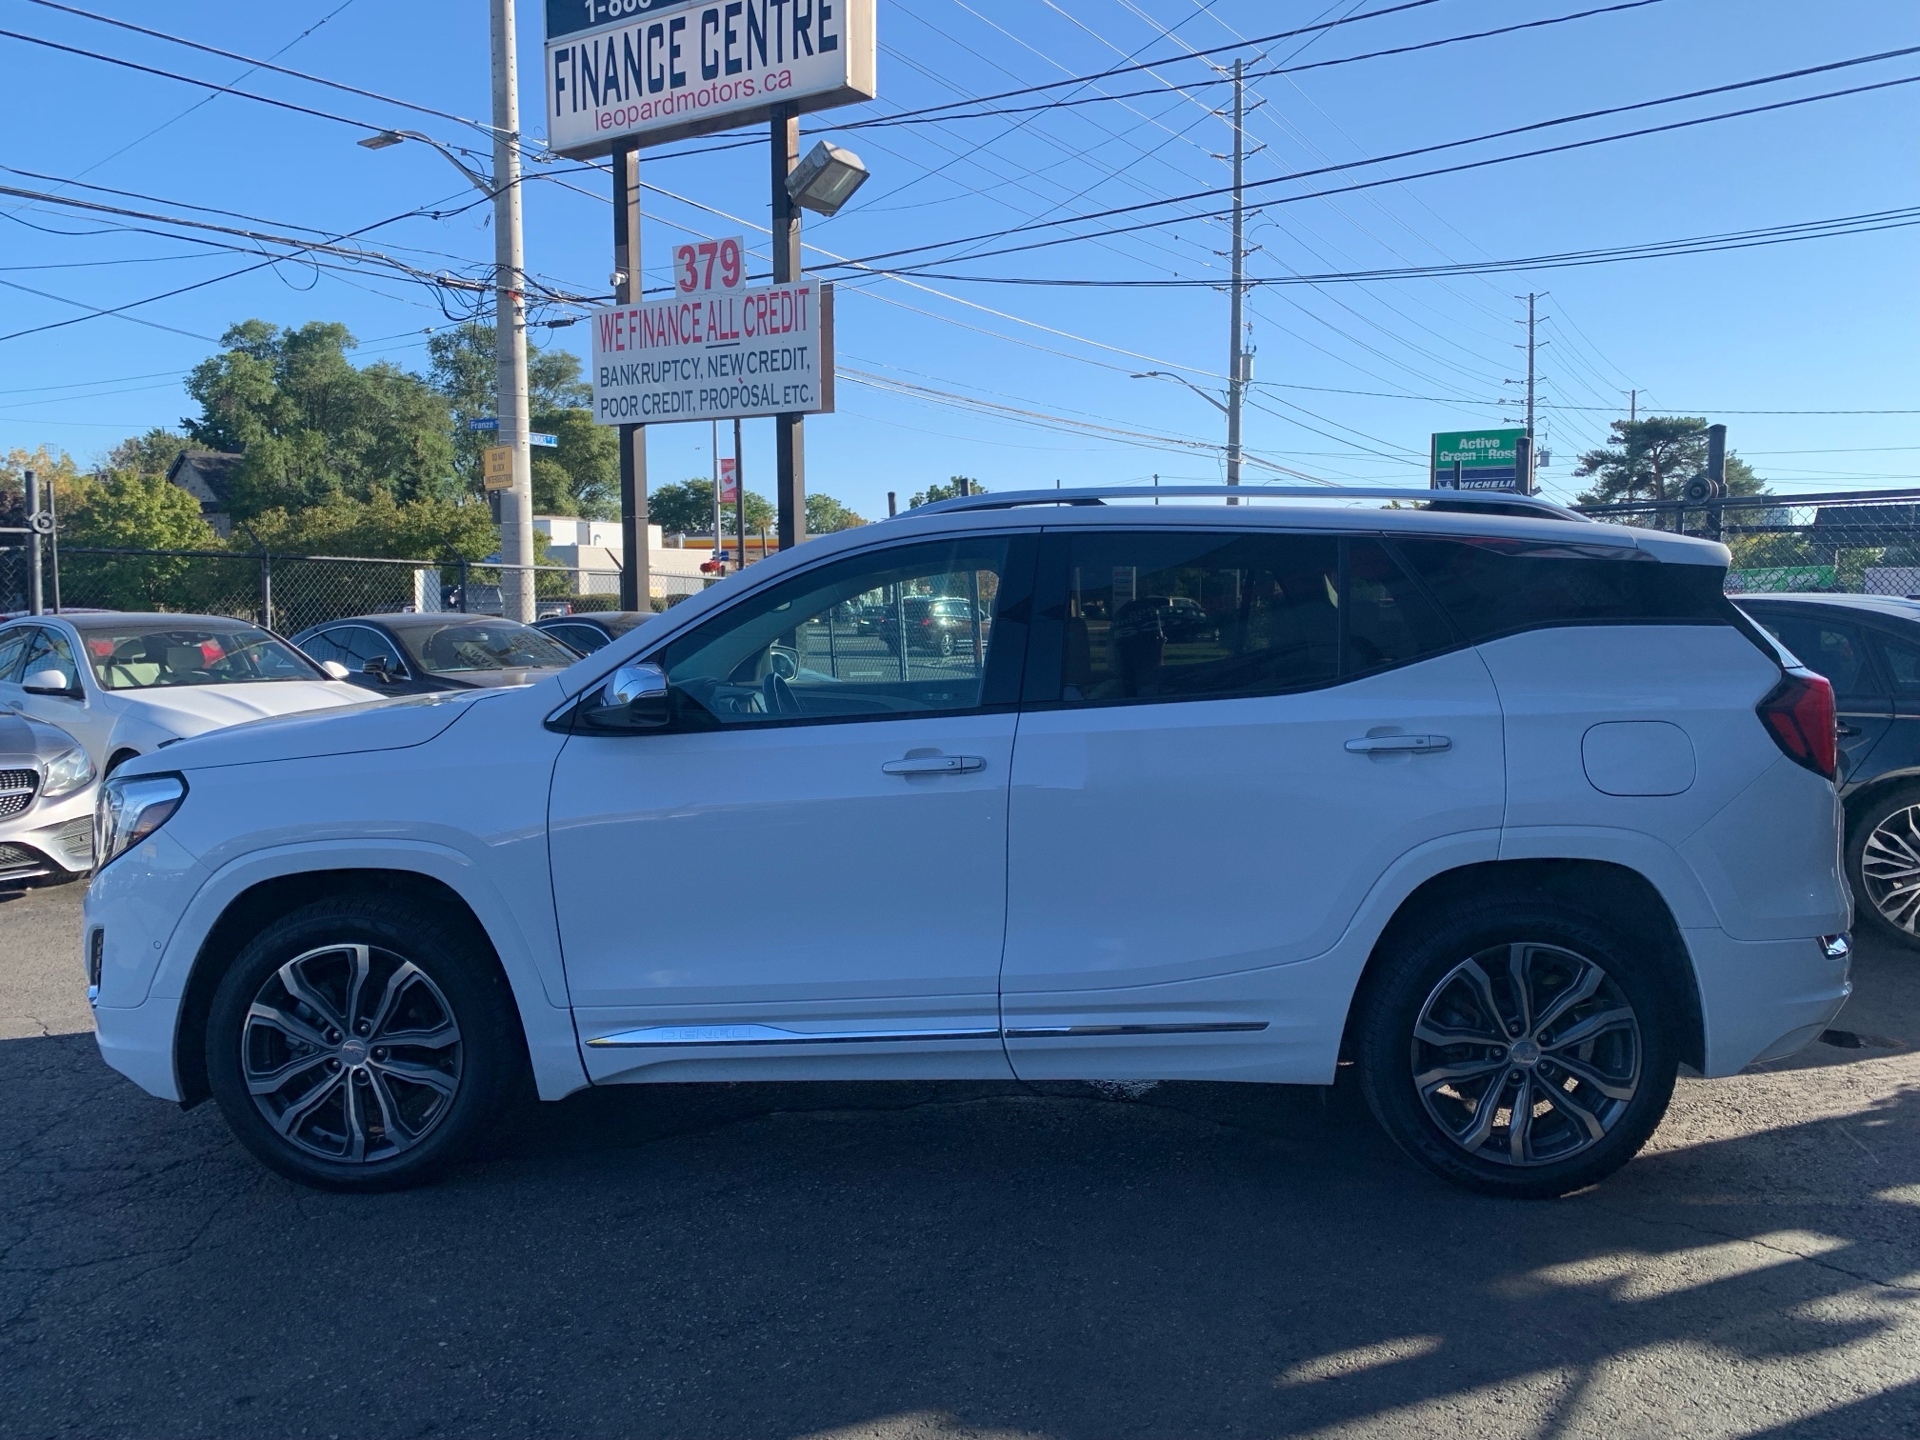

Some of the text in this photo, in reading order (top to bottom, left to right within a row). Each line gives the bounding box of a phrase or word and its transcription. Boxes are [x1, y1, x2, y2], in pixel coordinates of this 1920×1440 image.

[554, 0, 839, 117] FINANCE CENTRE
[594, 69, 793, 131] leopardmotors.ca
[677, 239, 741, 293] 379
[599, 287, 810, 353] WE FINANCE ALL CREDIT
[600, 346, 811, 388] BANKRUPTCY, NEW CREDIT,
[601, 394, 639, 419] POOR
[641, 389, 697, 416] CREDIT,
[783, 384, 814, 405] ETC.
[470, 421, 494, 430] Franze
[1458, 437, 1501, 450] Active
[1440, 450, 1477, 462] Green
[1488, 448, 1517, 460] Ross
[661, 1027, 755, 1040] DENALI
